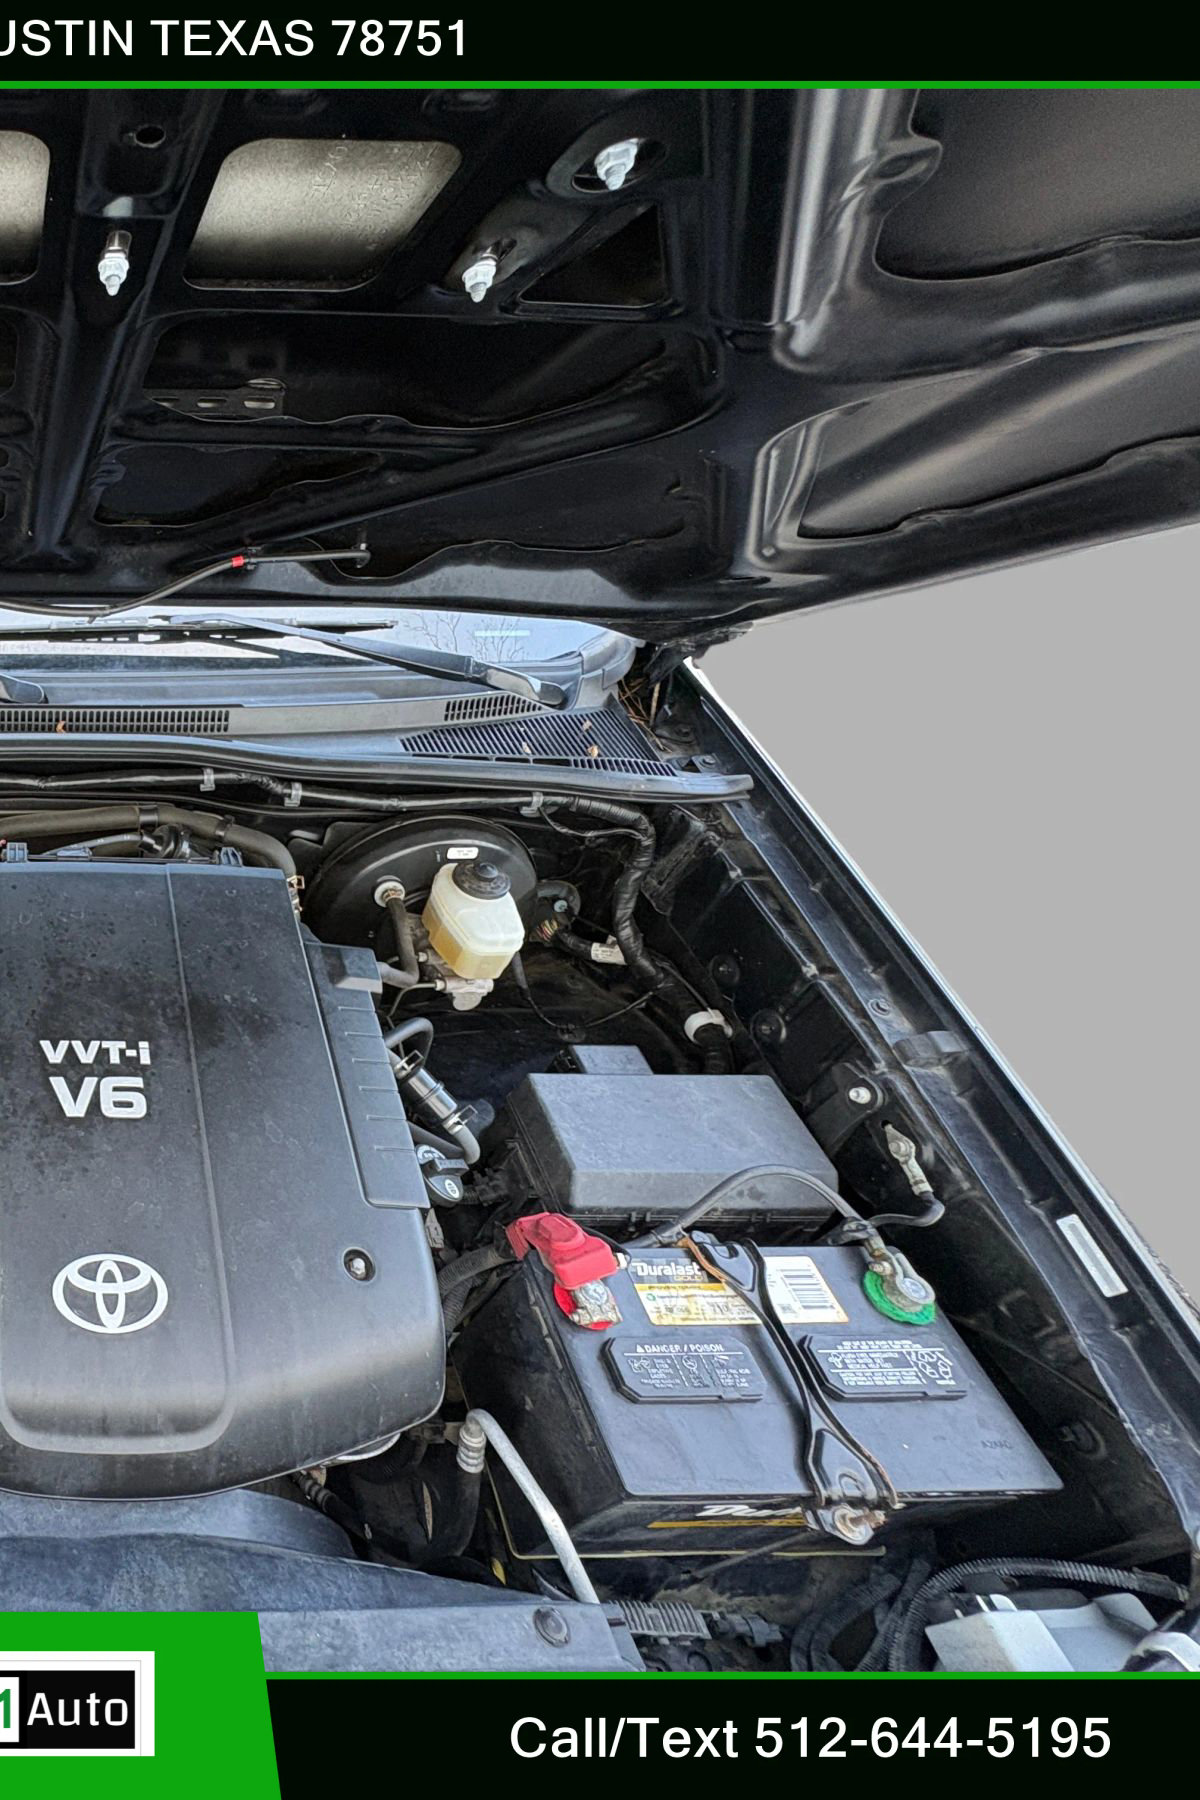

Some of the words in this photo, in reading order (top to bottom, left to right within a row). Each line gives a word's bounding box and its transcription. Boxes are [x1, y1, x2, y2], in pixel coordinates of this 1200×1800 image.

[39, 1040, 151, 1065] VVT-i
[49, 1076, 147, 1119] V6
[631, 1261, 701, 1276] Duralast
[644, 1344, 681, 1353] DANGER
[689, 1344, 725, 1352] POISON
